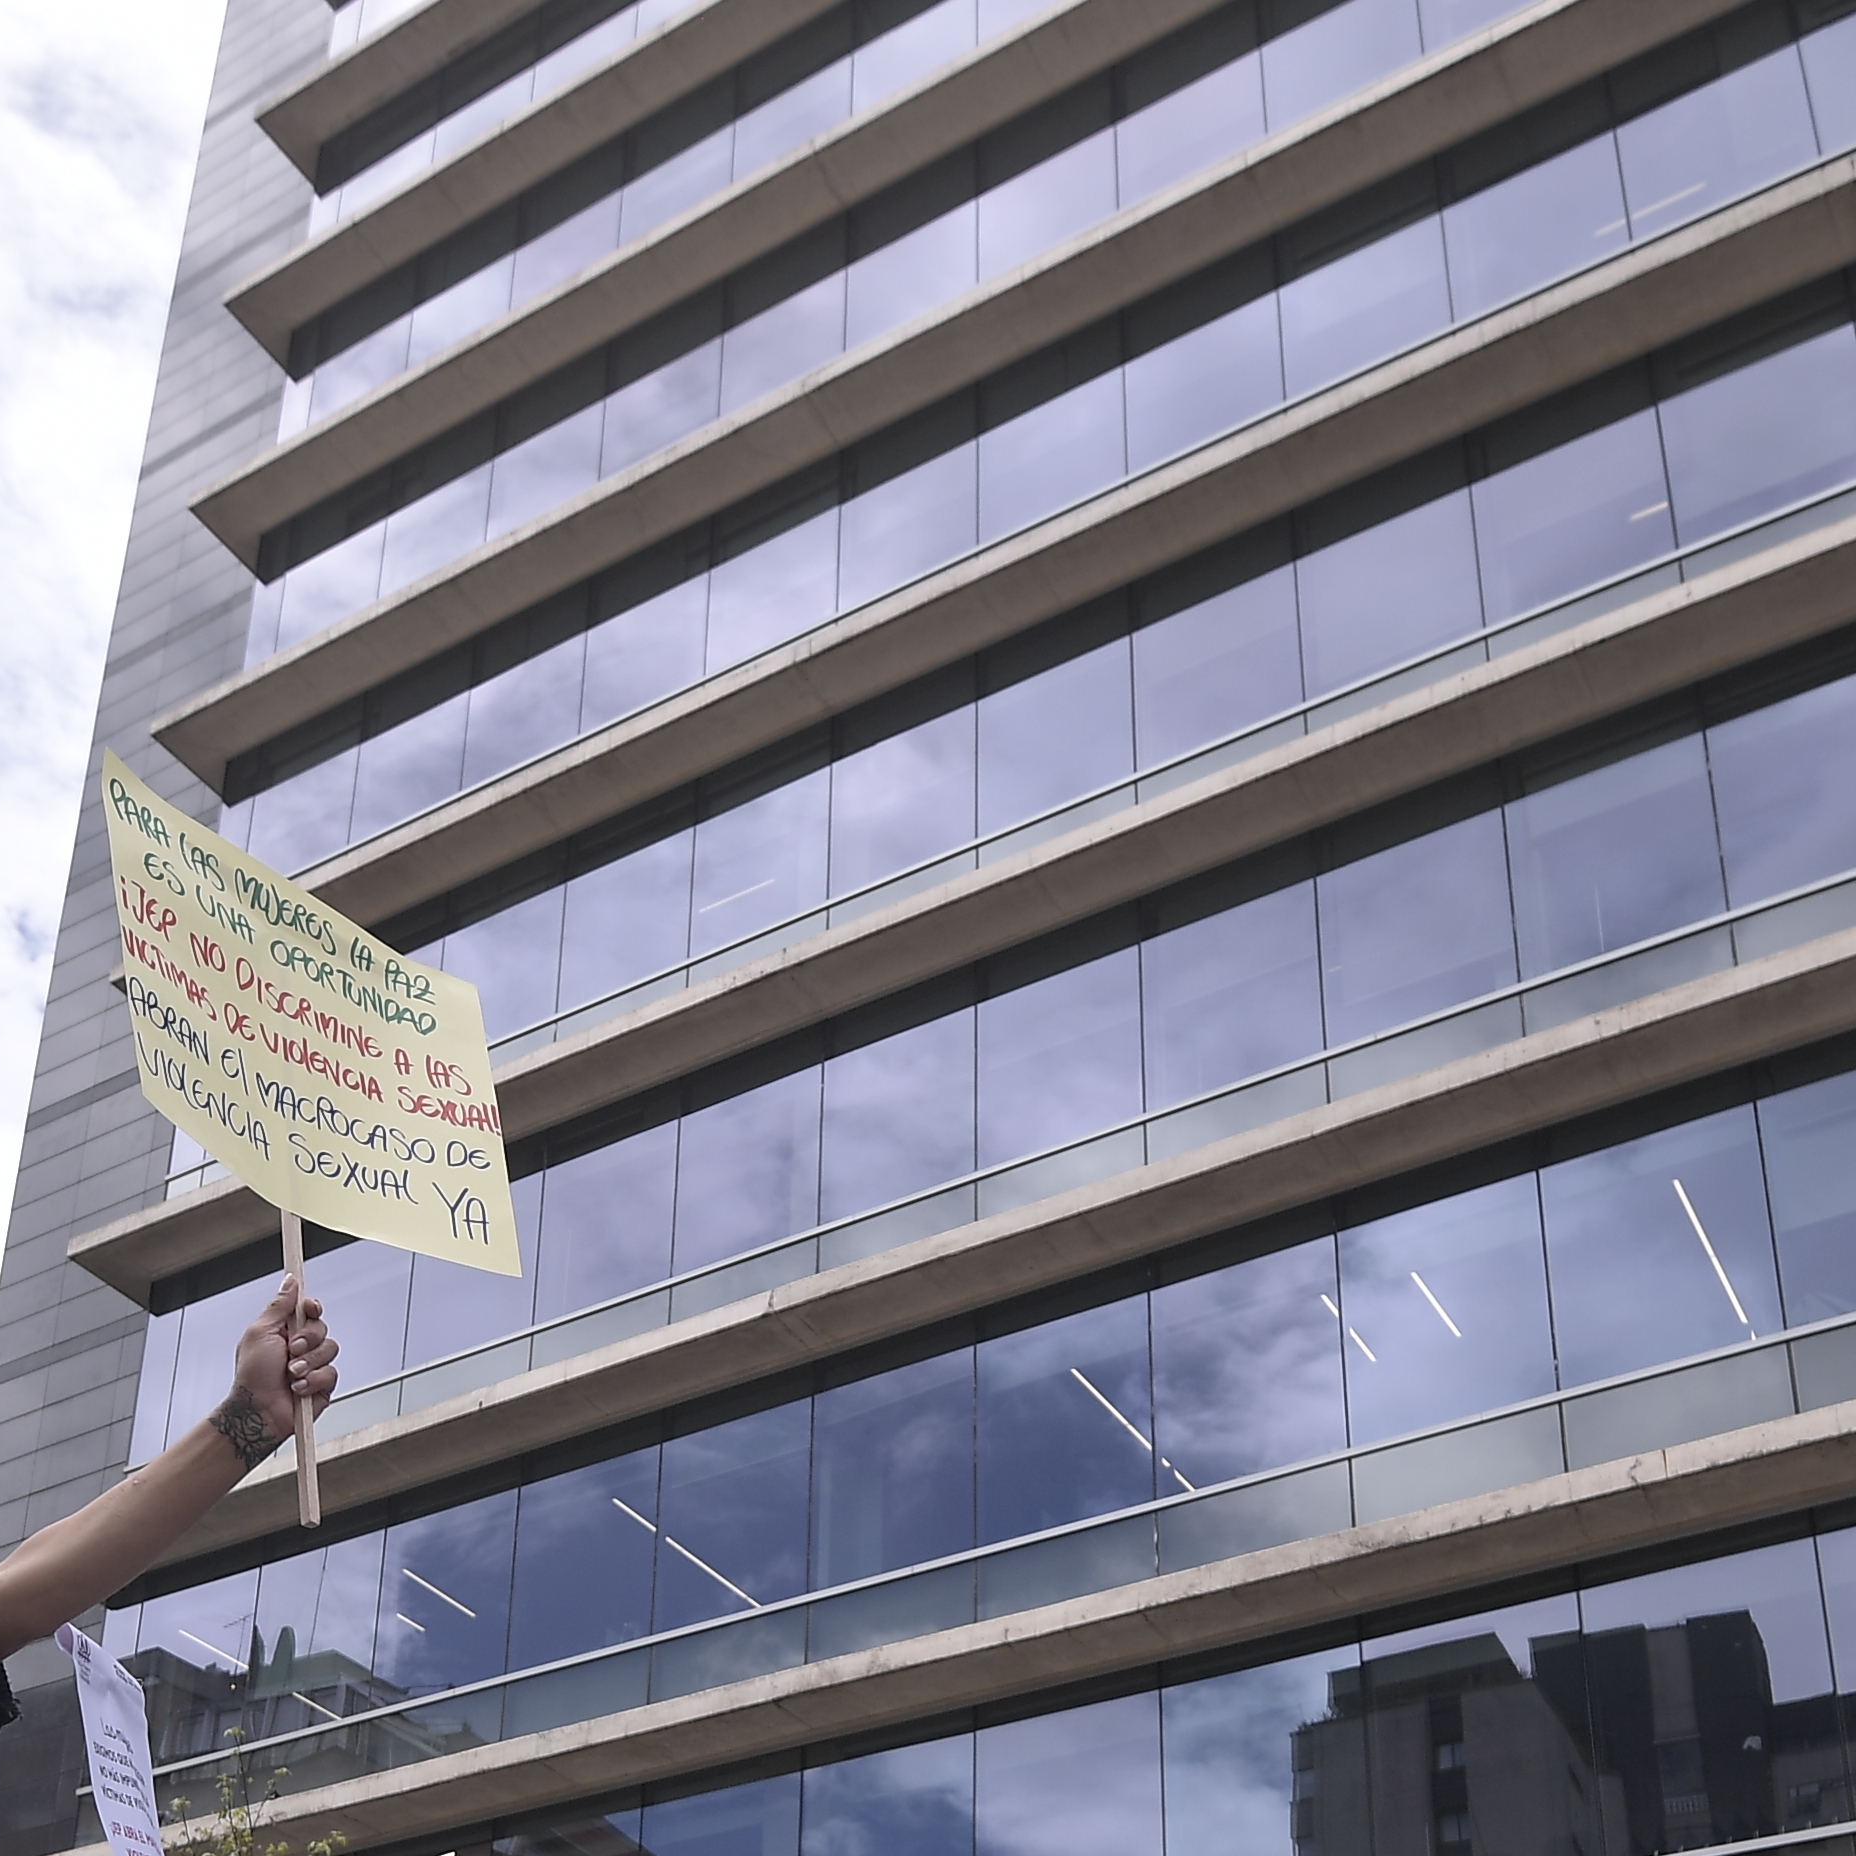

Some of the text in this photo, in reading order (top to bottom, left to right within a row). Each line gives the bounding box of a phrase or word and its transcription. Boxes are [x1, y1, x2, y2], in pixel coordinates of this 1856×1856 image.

[109, 777, 438, 1006] PARA LAS MUJERES LA PAZ
[143, 852, 438, 1036] ES UNA OPORTUNIDAD
[122, 925, 218, 1022] VICTIMAS
[224, 1003, 258, 1043] DE
[260, 1022, 385, 1105] VIOLENCIA
[127, 975, 212, 1067] ABRAN
[255, 1071, 437, 1166] MACROCASO
[446, 1139, 492, 1172] DE
[189, 933, 227, 974] NO
[233, 956, 384, 1059] DISCRIMINE
[392, 1047, 415, 1076] A
[425, 1055, 473, 1097] LAS
[136, 1031, 492, 1246] VIOLENCIA SEXUAL YA
